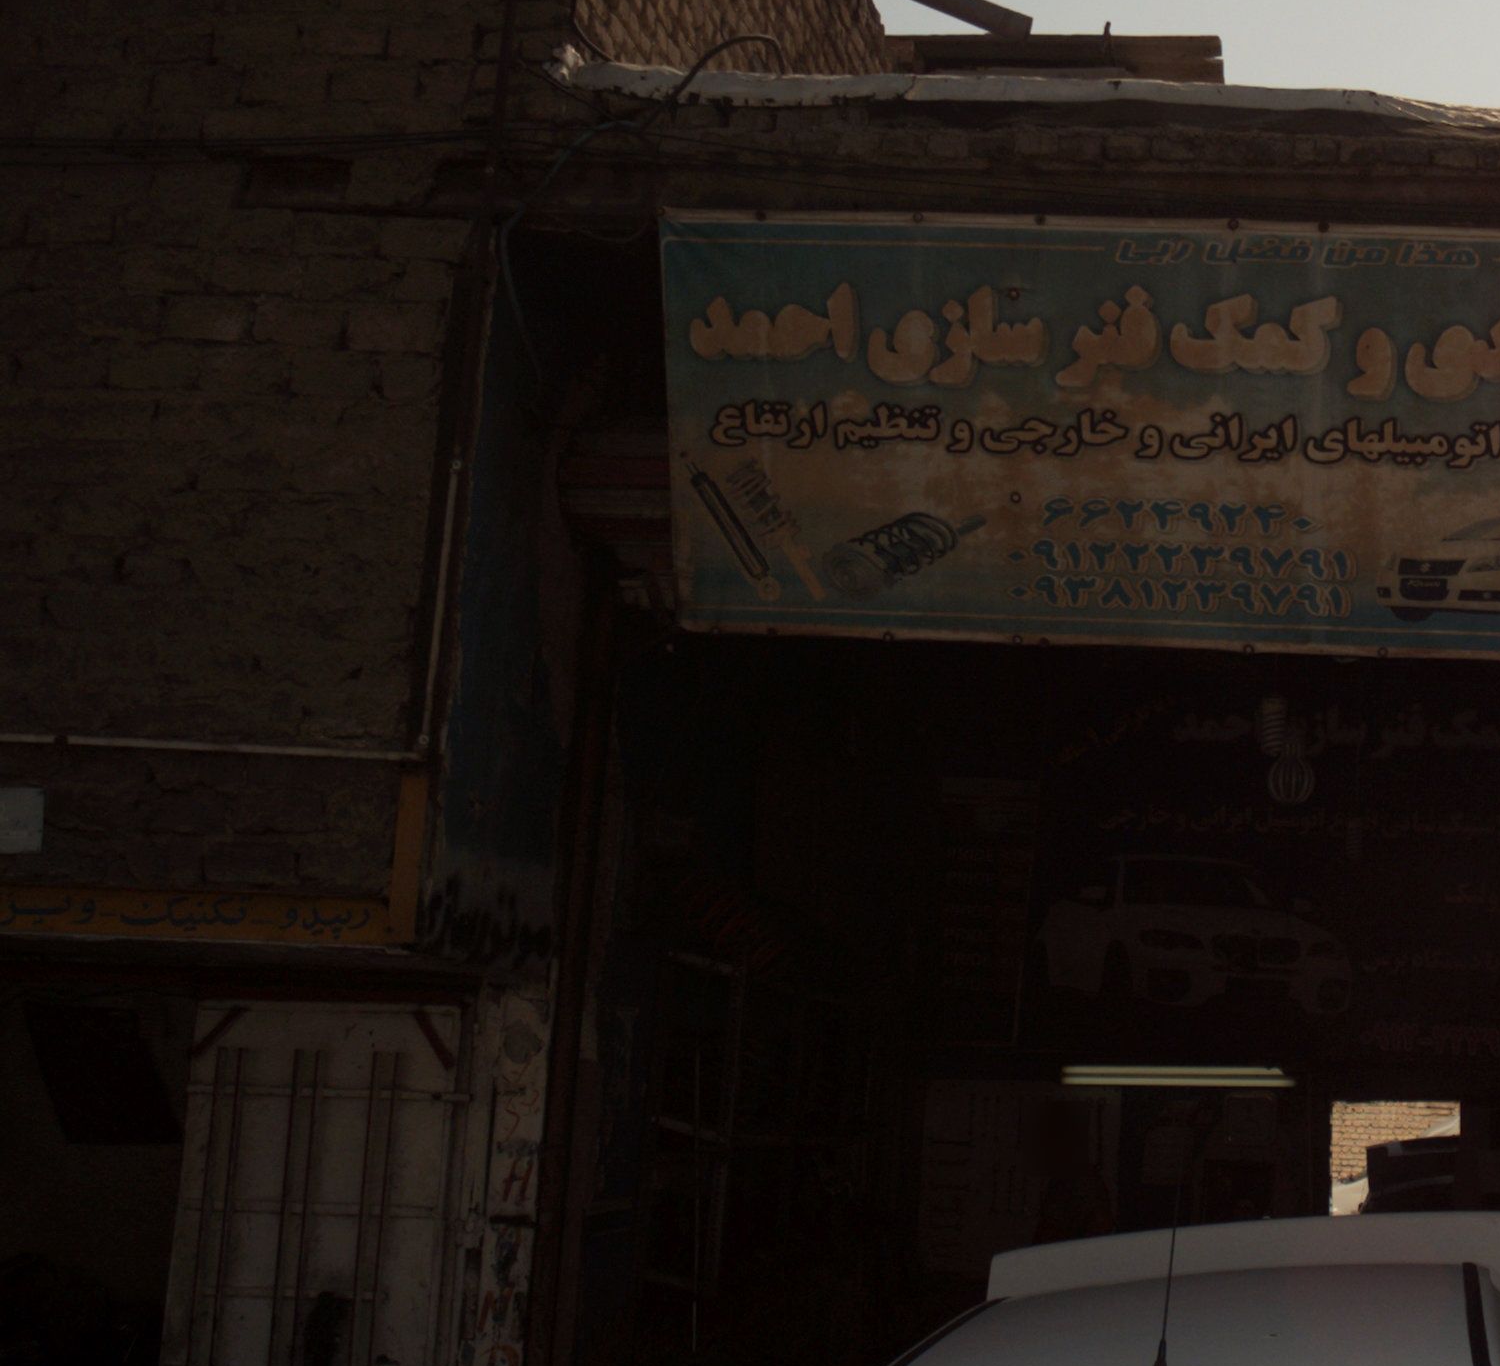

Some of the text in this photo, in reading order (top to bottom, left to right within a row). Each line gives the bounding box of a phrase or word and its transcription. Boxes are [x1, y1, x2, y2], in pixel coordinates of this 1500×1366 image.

[689, 281, 858, 363] احمد
[866, 285, 1048, 388] سازی
[1055, 285, 1163, 387] فنر
[1170, 293, 1344, 376] کمک
[1346, 327, 1396, 401] و
[711, 399, 827, 449] ارتفاع
[834, 402, 943, 449] تنظیم
[946, 418, 975, 454] و
[980, 407, 1128, 457] خارجی
[1136, 423, 1163, 459] و
[1170, 413, 1298, 462] ایرانی
